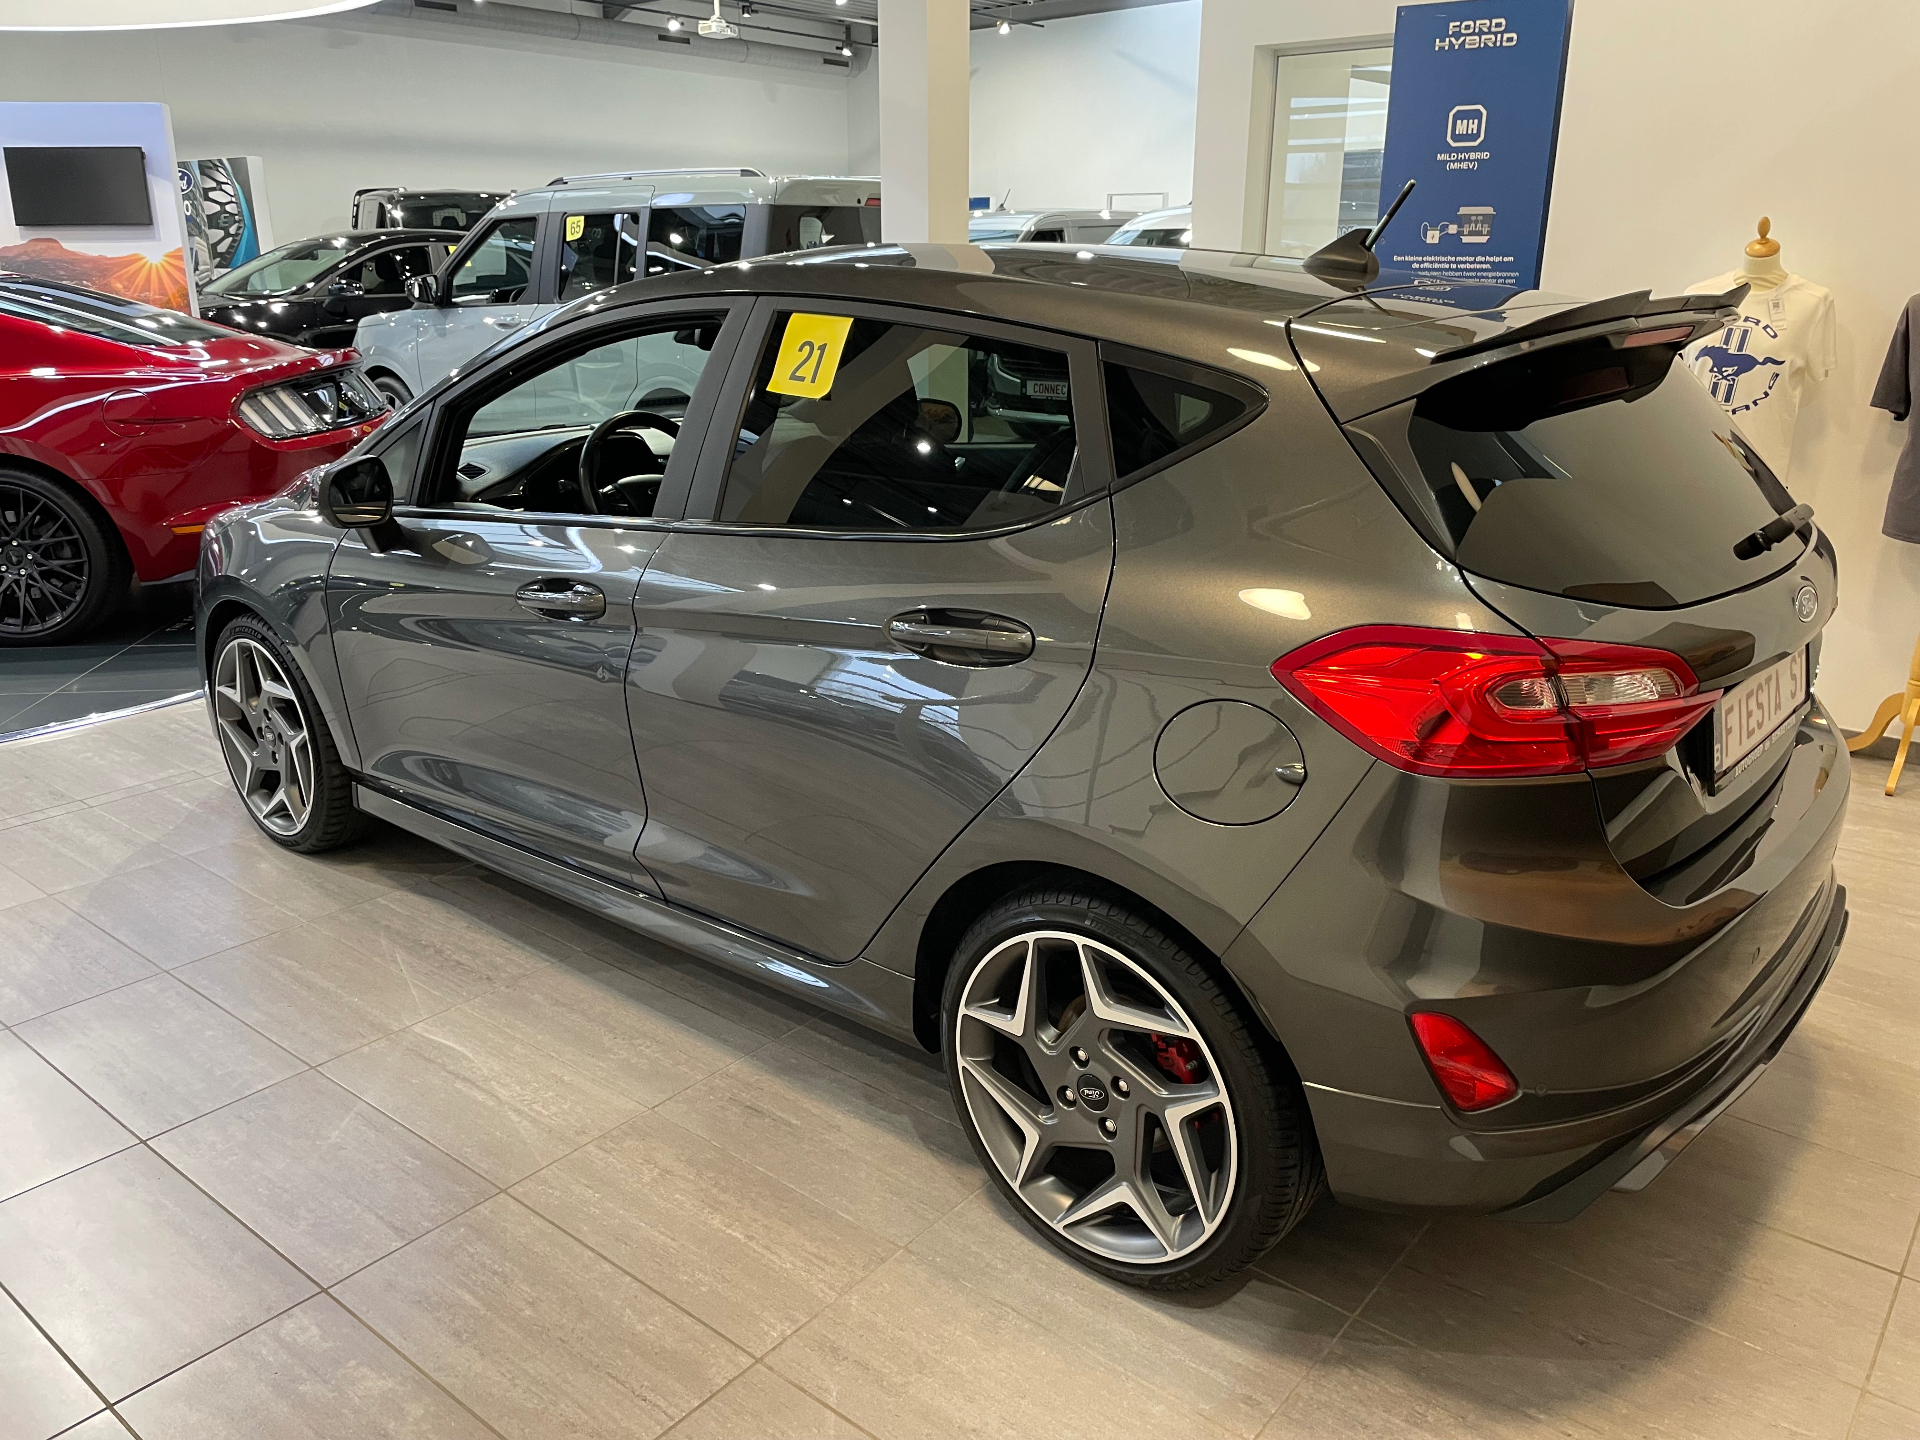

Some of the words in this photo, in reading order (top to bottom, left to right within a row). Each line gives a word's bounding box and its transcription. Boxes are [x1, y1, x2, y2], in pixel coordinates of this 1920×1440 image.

[1448, 18, 1506, 35] FORD
[1435, 32, 1518, 51] HYBRID
[1455, 119, 1479, 135] MH
[1436, 152, 1458, 161] MILD
[1457, 151, 1490, 160] HYBRID
[1446, 161, 1478, 171] (MHEV)
[570, 220, 581, 236] 65
[788, 340, 828, 384] 21
[1033, 383, 1067, 395] CONNEC
[1724, 668, 1783, 759] FIESTA
[1789, 650, 1805, 700] ST
[1714, 743, 1722, 765] B
